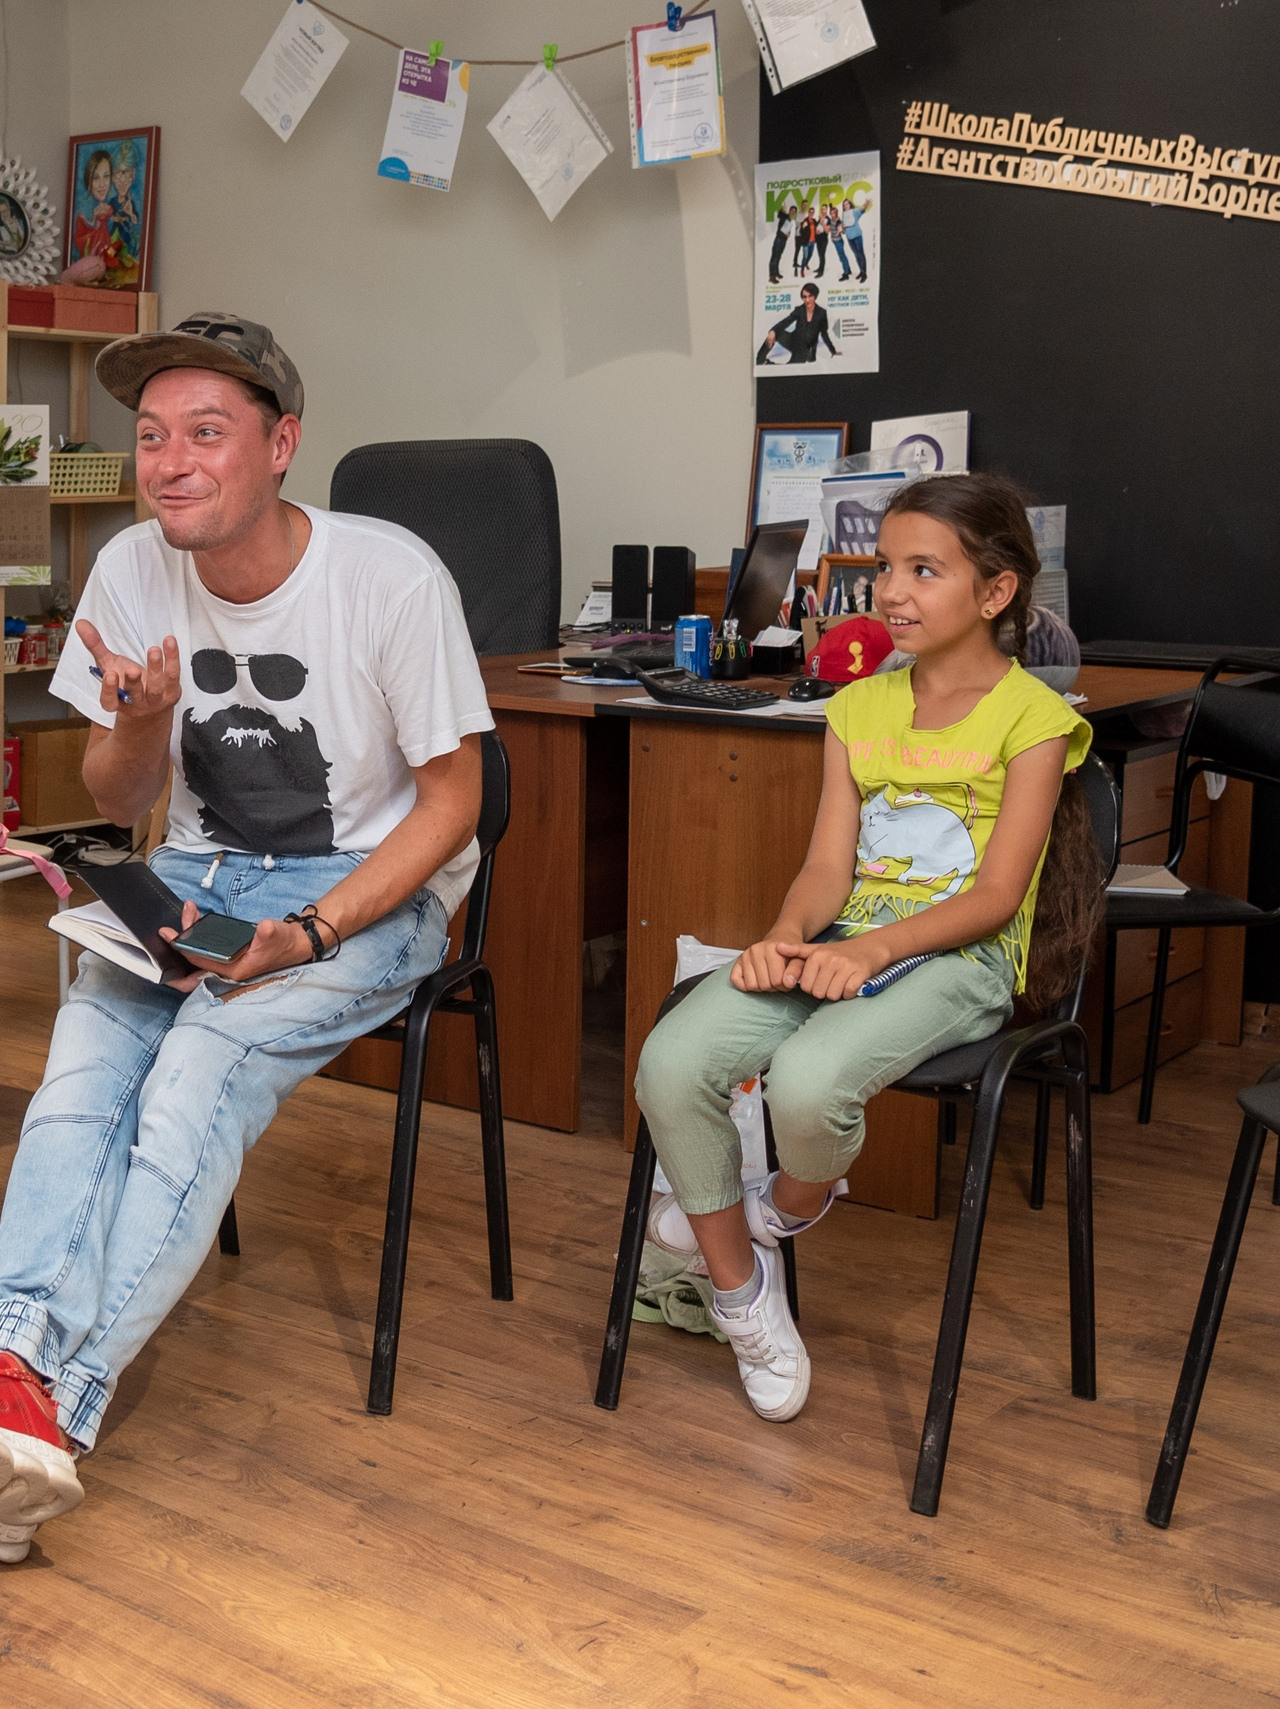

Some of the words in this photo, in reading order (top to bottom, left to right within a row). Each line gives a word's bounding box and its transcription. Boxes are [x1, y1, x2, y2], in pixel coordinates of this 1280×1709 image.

[766, 174, 842, 189] ПОДРОСТКОВЫЙ
[765, 181, 874, 222] КУРС
[765, 294, 792, 304] 23-28
[765, 303, 792, 312] марта
[881, 737, 897, 756] IS
